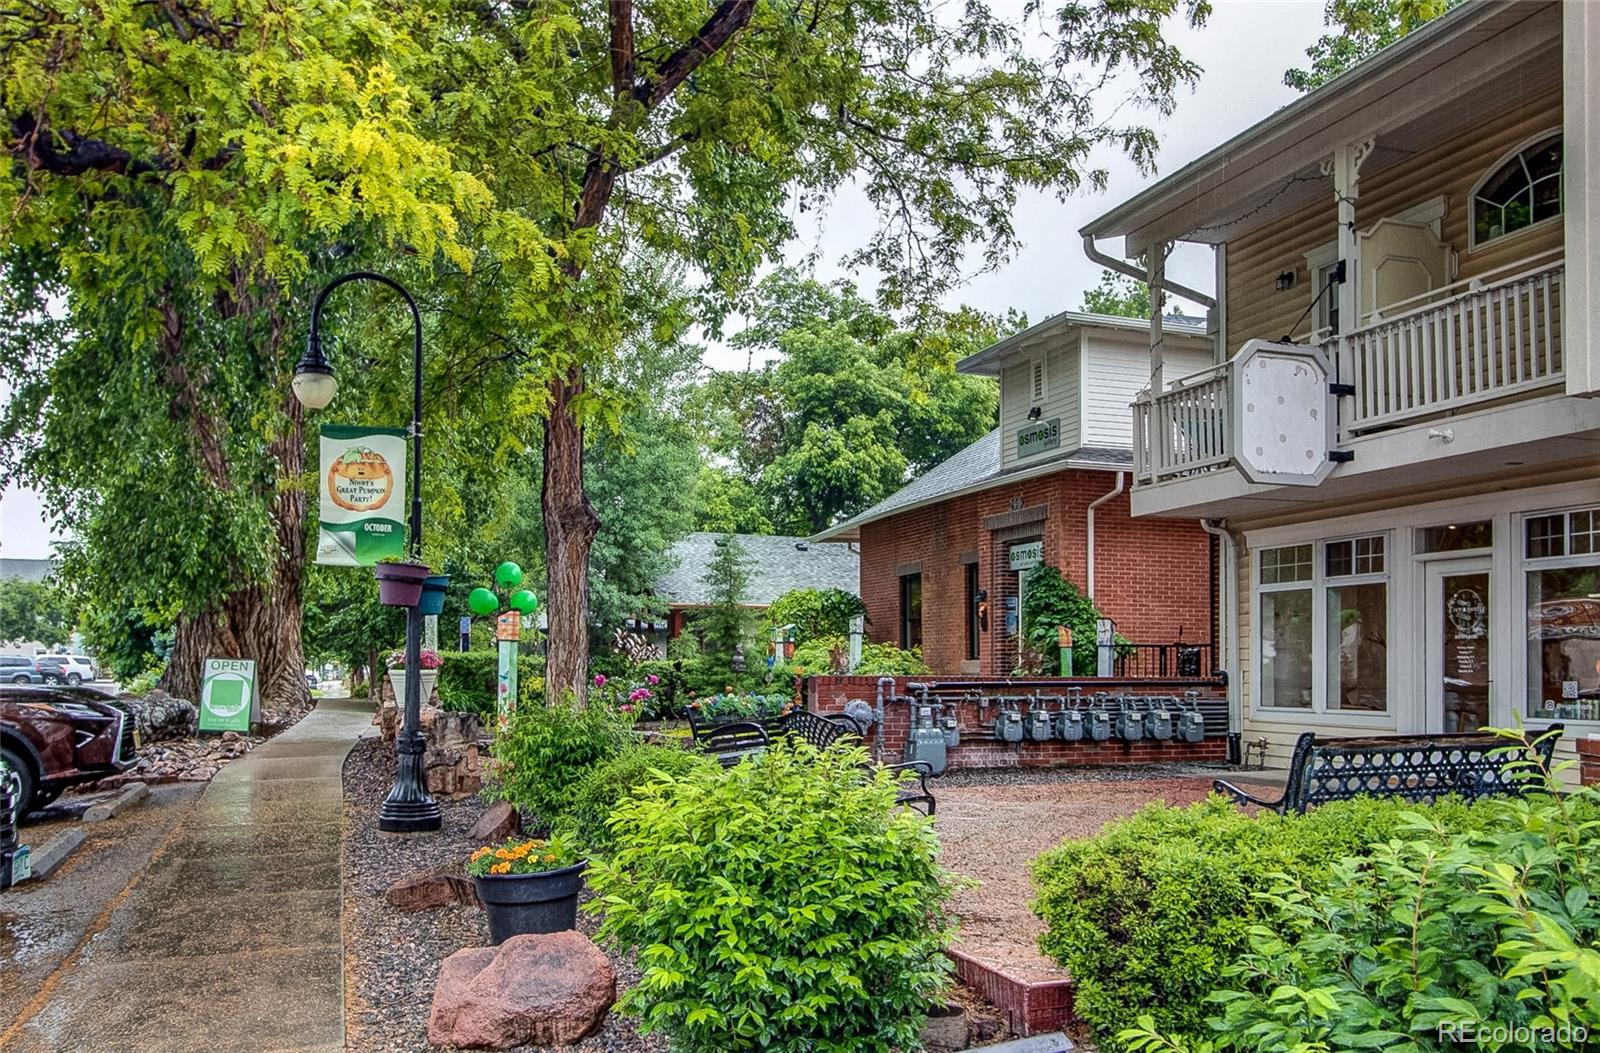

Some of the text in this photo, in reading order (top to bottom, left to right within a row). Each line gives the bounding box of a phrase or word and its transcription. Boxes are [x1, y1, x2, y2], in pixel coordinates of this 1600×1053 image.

[1019, 424, 1058, 446] osmosis
[364, 523, 392, 532] OCTOBER
[211, 660, 249, 671] OPEN
